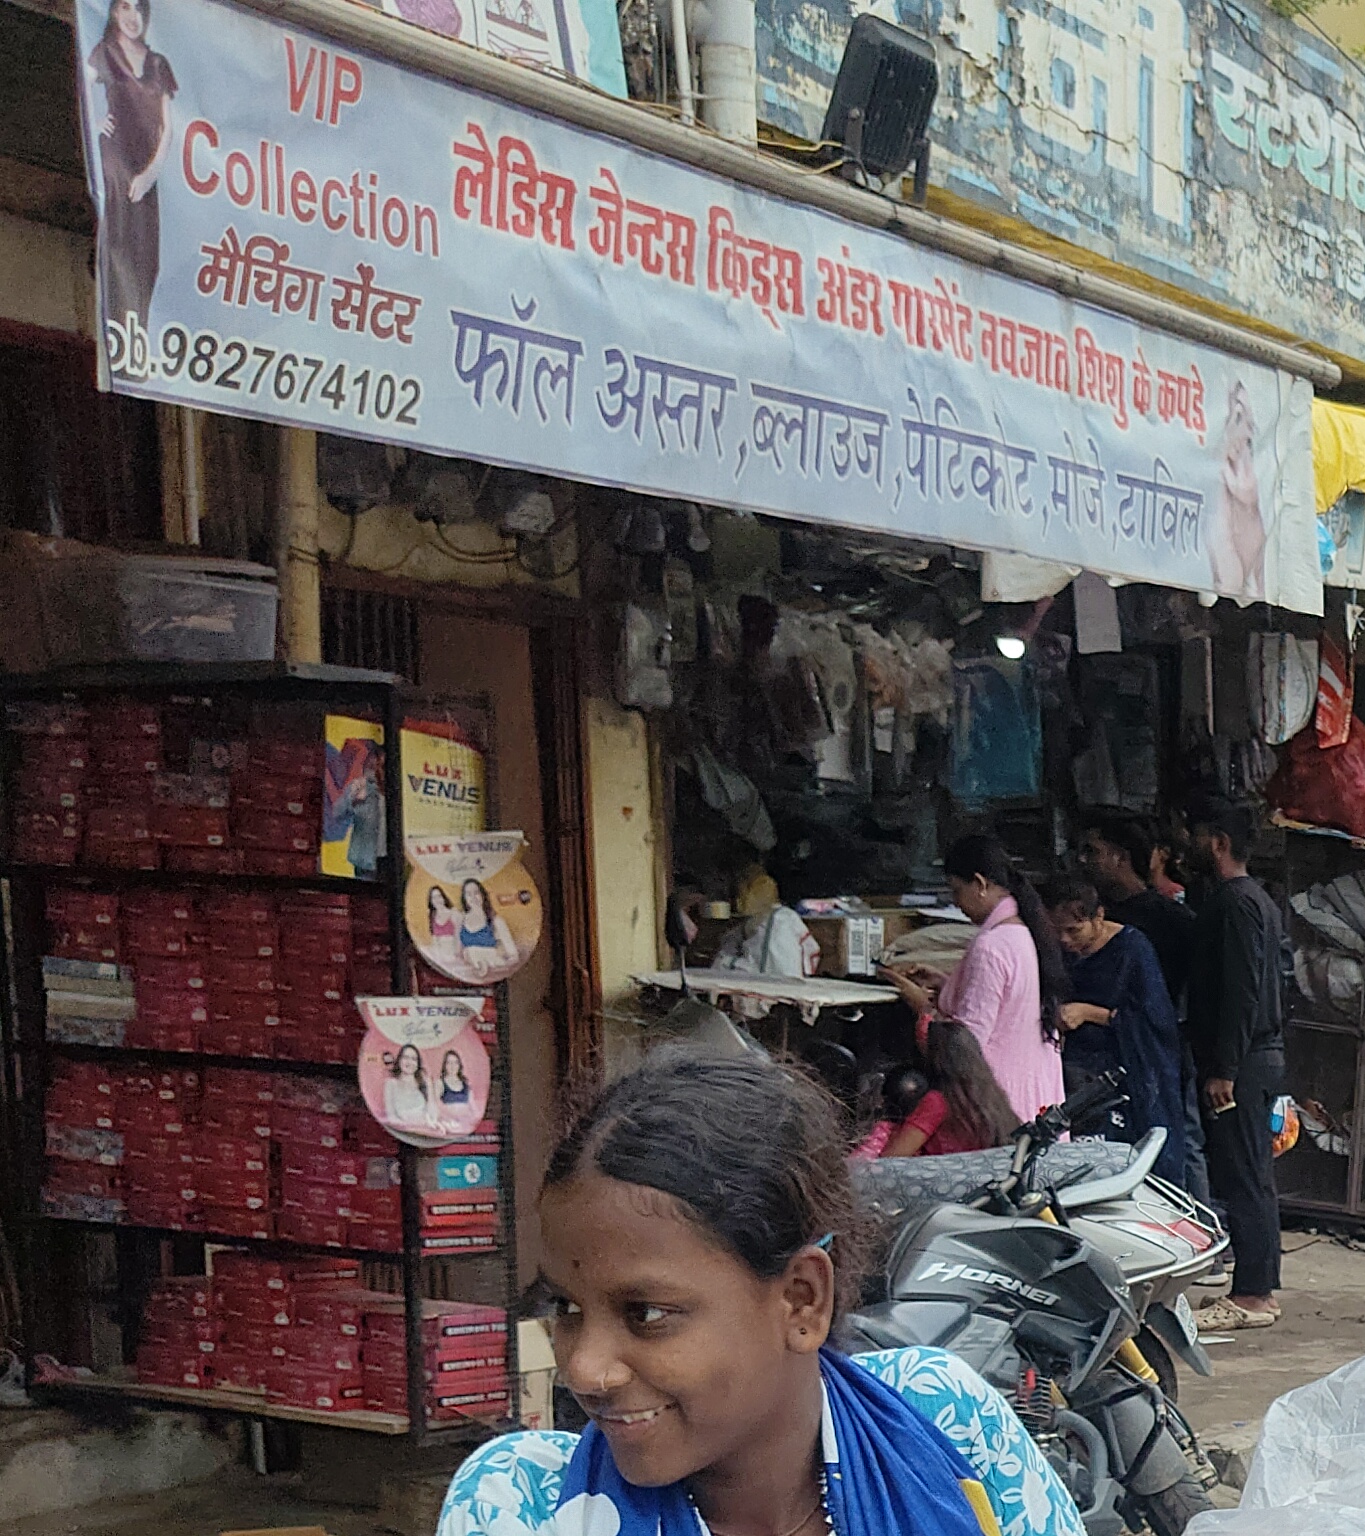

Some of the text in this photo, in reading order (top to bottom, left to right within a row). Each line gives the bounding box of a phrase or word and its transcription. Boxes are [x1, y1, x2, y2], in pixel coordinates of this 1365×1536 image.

[285, 37, 363, 127] VIP
[182, 119, 441, 257] Collection
[200, 227, 421, 344] मैचिंग सेंटर
[454, 122, 577, 250] लेडिस
[589, 168, 697, 286] जेन्टस
[708, 205, 805, 330] किड्स
[816, 245, 886, 337] अंडर
[979, 310, 1071, 394] नवजात
[1075, 327, 1129, 431] शिशु
[1132, 346, 1153, 416] के
[1157, 361, 1207, 445] कपड़े
[450, 292, 585, 427] फॉल
[407, 774, 480, 805] VENUS
[423, 762, 463, 779] LUX
[416, 844, 451, 856] LUX
[374, 1004, 410, 1017] LUX
[917, 1262, 1060, 1305] HORNET
